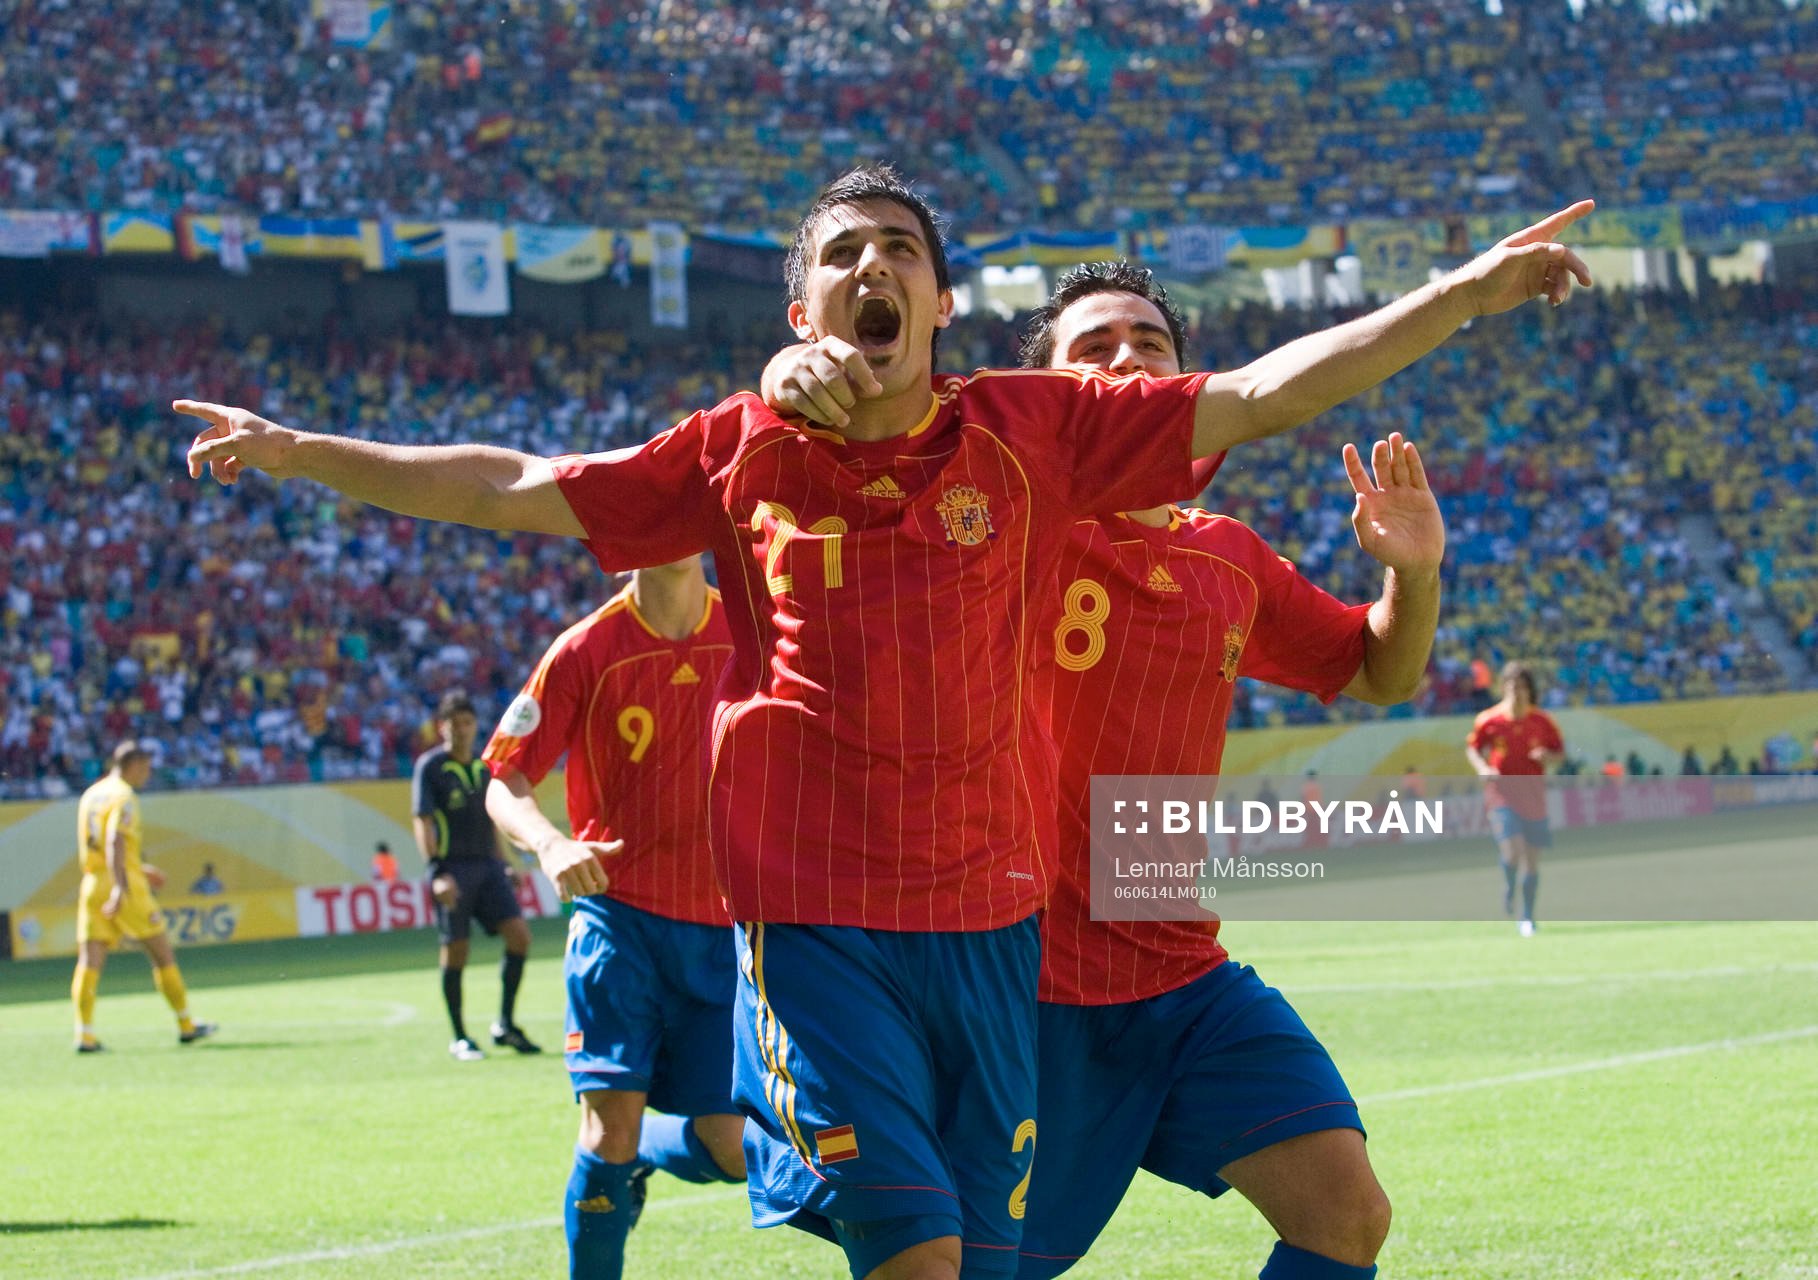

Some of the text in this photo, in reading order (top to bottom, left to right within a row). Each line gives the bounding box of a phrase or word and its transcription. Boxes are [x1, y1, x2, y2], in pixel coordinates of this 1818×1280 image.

[751, 500, 848, 597] 21
[1147, 580, 1183, 593] adidas
[1054, 578, 1110, 671] 8
[617, 705, 654, 763] 9
[1008, 1118, 1037, 1220] 2
